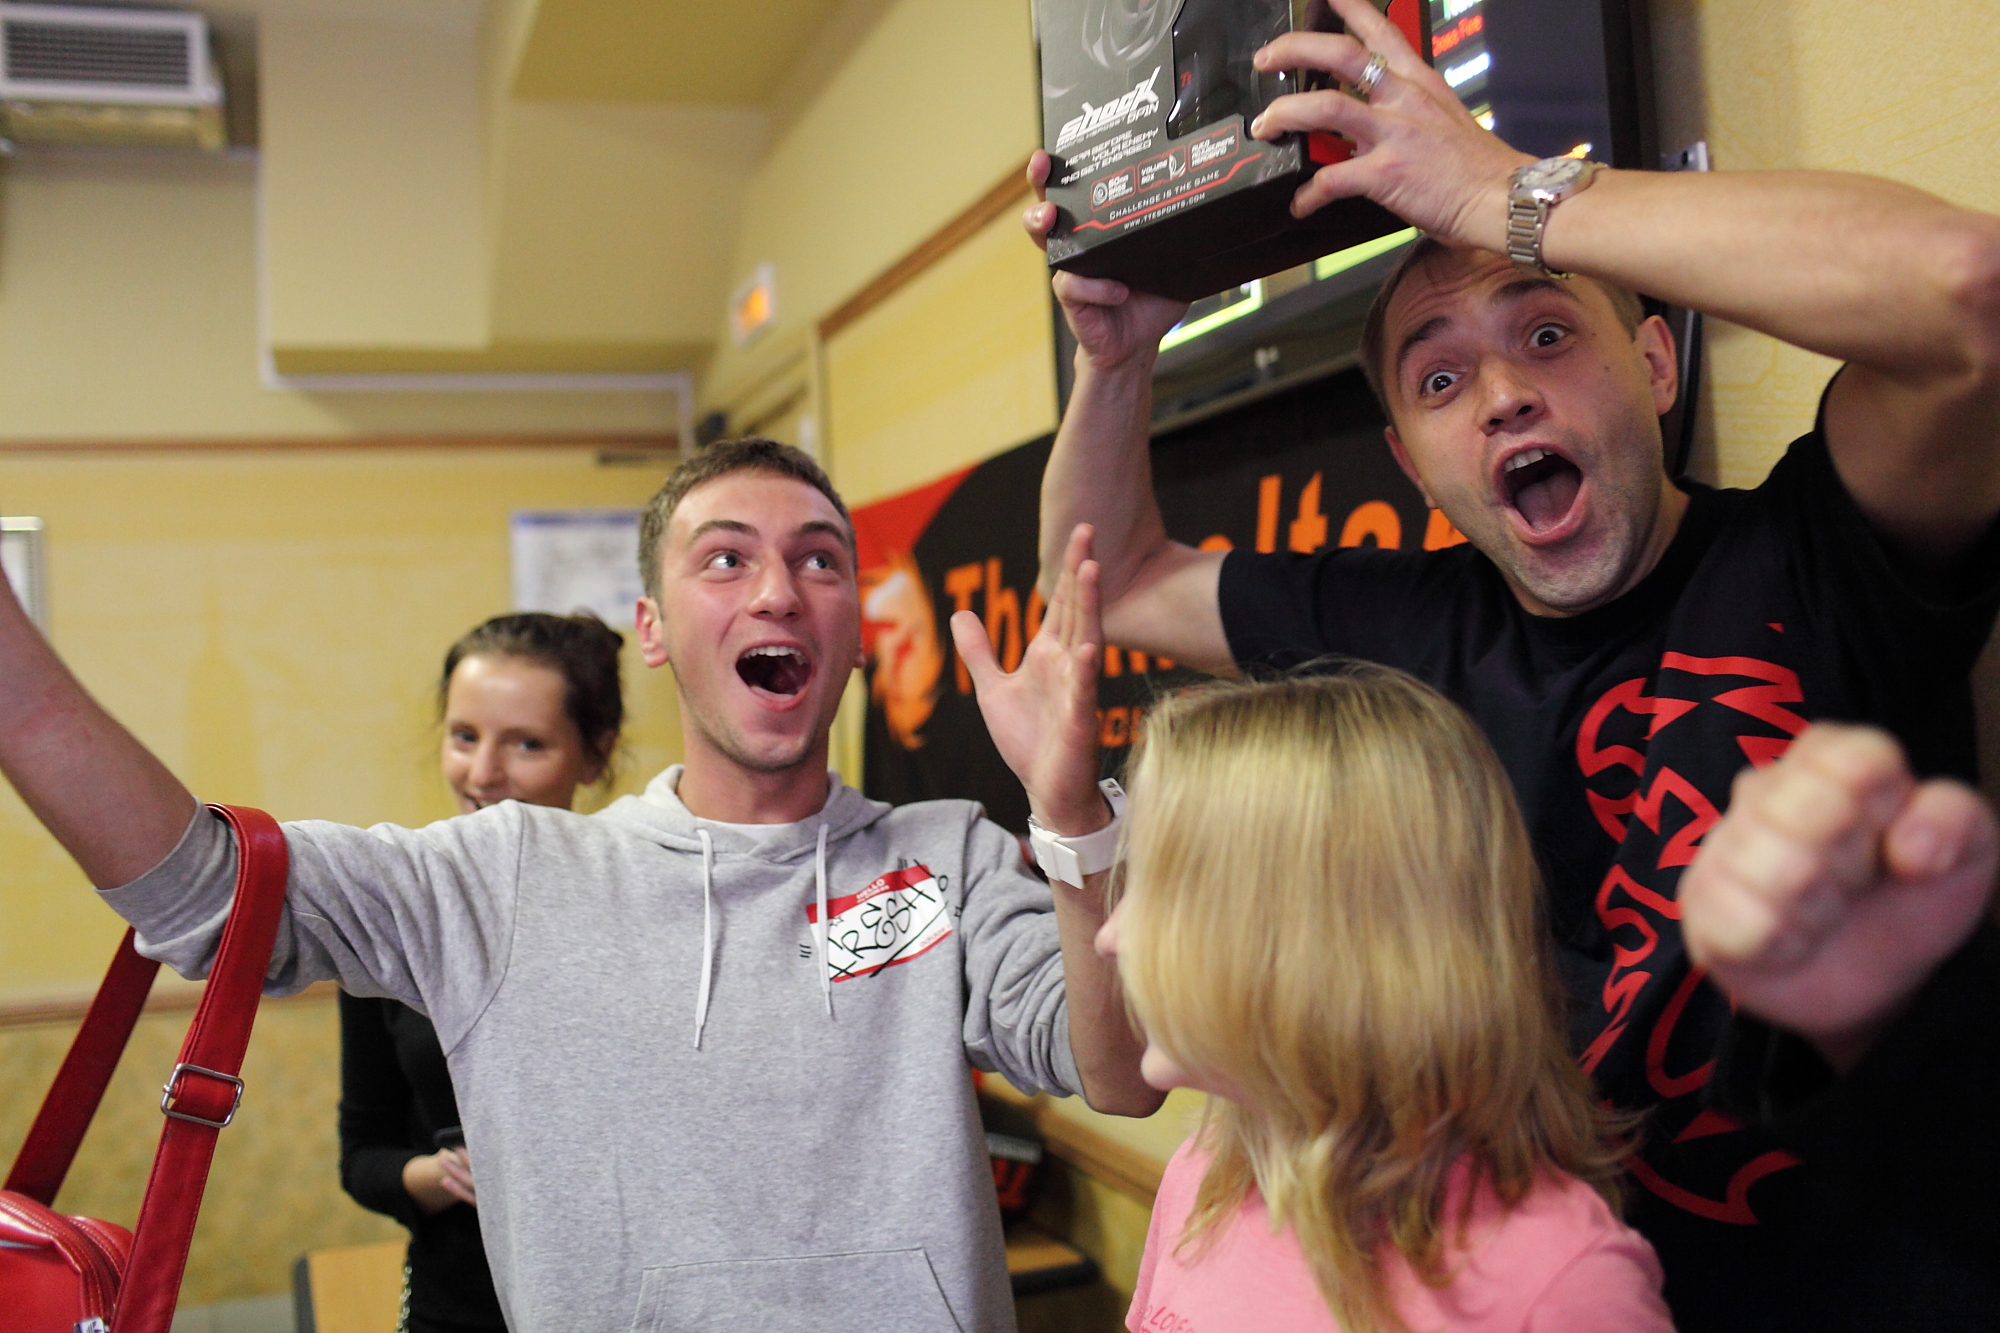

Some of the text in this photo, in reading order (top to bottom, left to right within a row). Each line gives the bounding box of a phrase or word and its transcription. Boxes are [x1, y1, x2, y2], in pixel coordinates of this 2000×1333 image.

[1061, 139, 1152, 185] AND GET ENGAGED
[1065, 130, 1132, 168] HEAR BEFORE
[1092, 127, 1158, 162] YOUR ENEMY
[1141, 159, 1168, 176] VOLUME
[1141, 173, 1155, 185] BOX
[1109, 194, 1161, 221] CHALLENGE
[1163, 188, 1172, 200] IS
[1175, 181, 1192, 195] THE
[1194, 169, 1221, 185] GAME
[856, 878, 886, 900] HELLO
